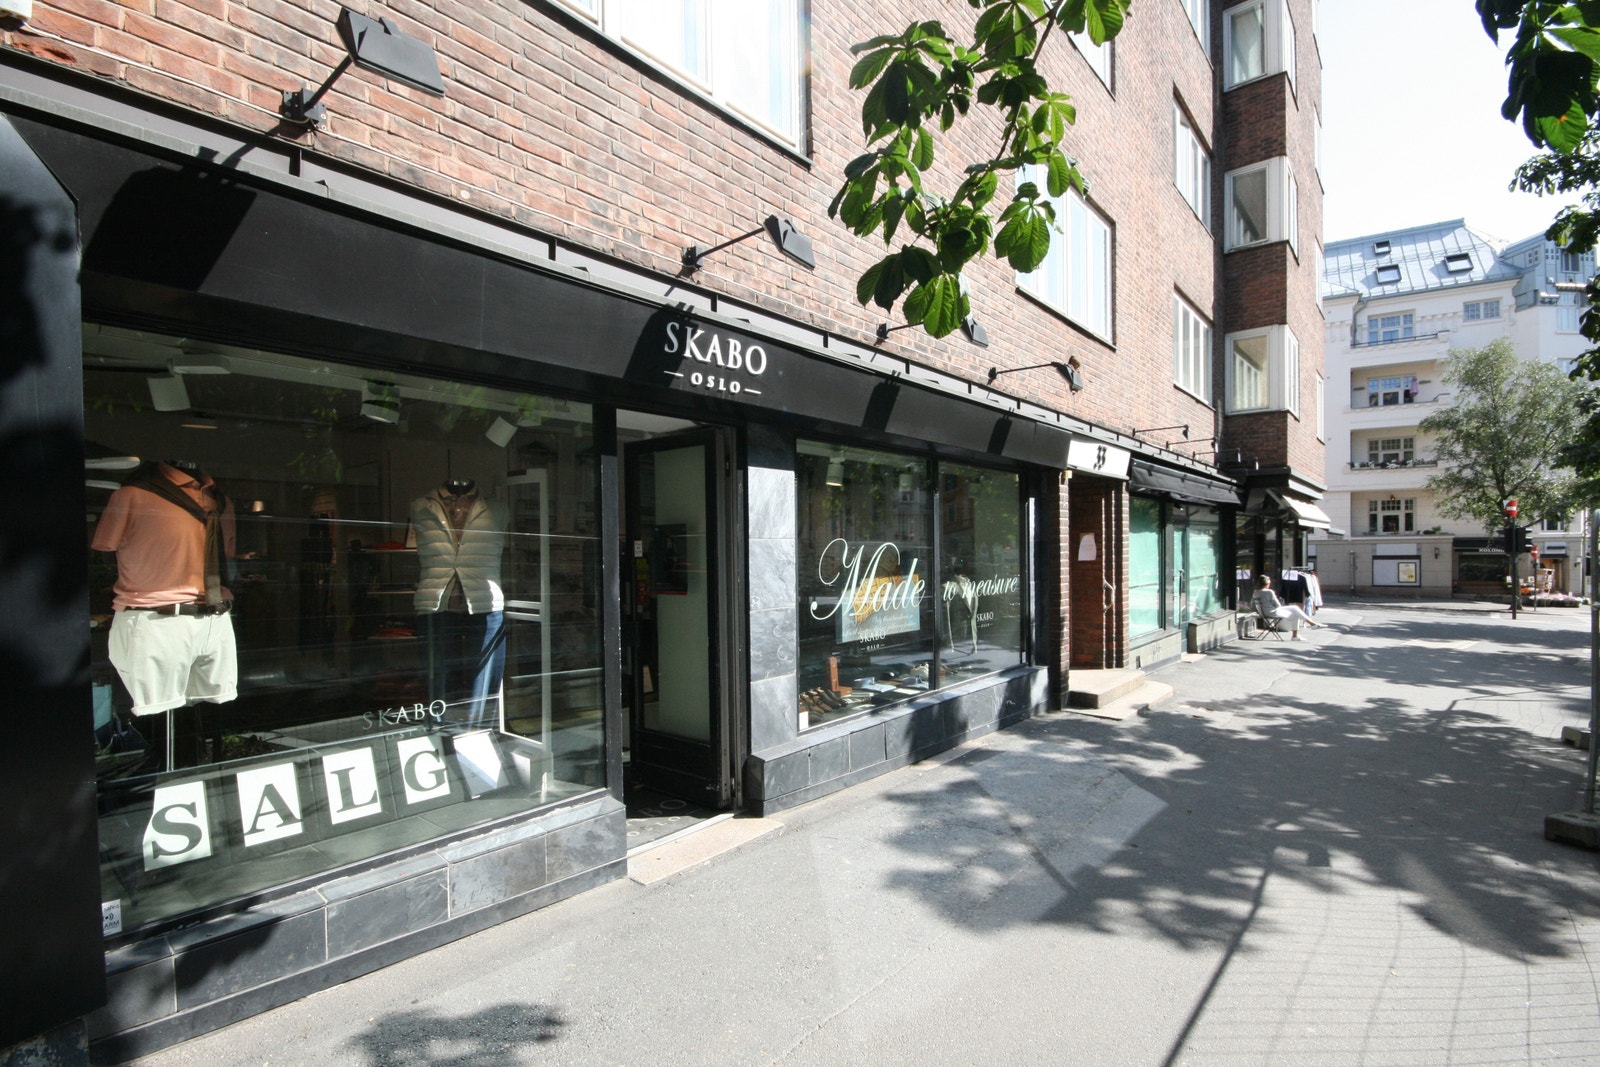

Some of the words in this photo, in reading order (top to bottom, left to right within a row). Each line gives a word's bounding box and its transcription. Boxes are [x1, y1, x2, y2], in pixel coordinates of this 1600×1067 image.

[664, 321, 768, 376] SKABO
[690, 372, 742, 394] OSLO
[809, 537, 926, 621] Made
[942, 580, 959, 602] to
[961, 573, 1019, 599] measure
[976, 611, 995, 623] SKABO
[858, 628, 887, 644] SKABO
[362, 699, 447, 731] SKABO
[151, 747, 451, 860] SALG
